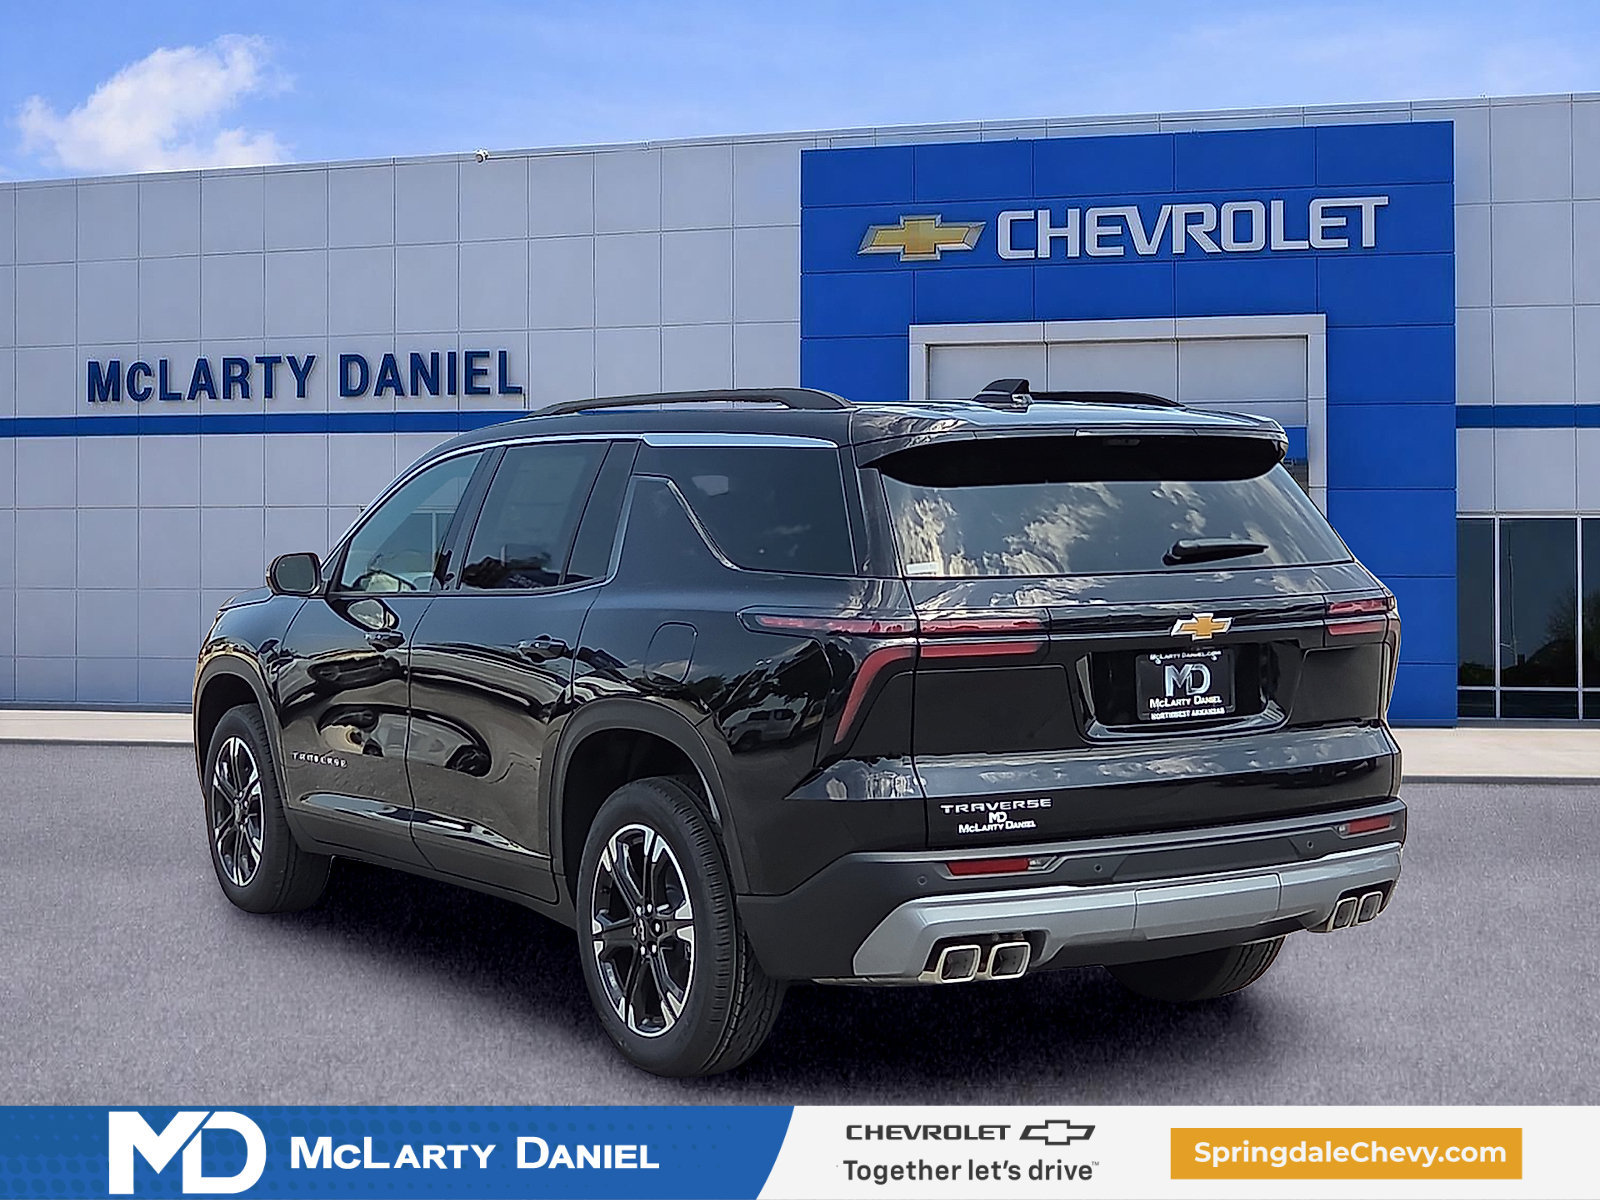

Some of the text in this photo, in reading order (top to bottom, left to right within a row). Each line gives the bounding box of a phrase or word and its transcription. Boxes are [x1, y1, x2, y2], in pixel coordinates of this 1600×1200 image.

[997, 196, 1389, 260] CHEVROLET
[339, 350, 524, 399] DANIEL
[1164, 663, 1211, 697] MD
[940, 798, 1052, 814] TRAVERSE
